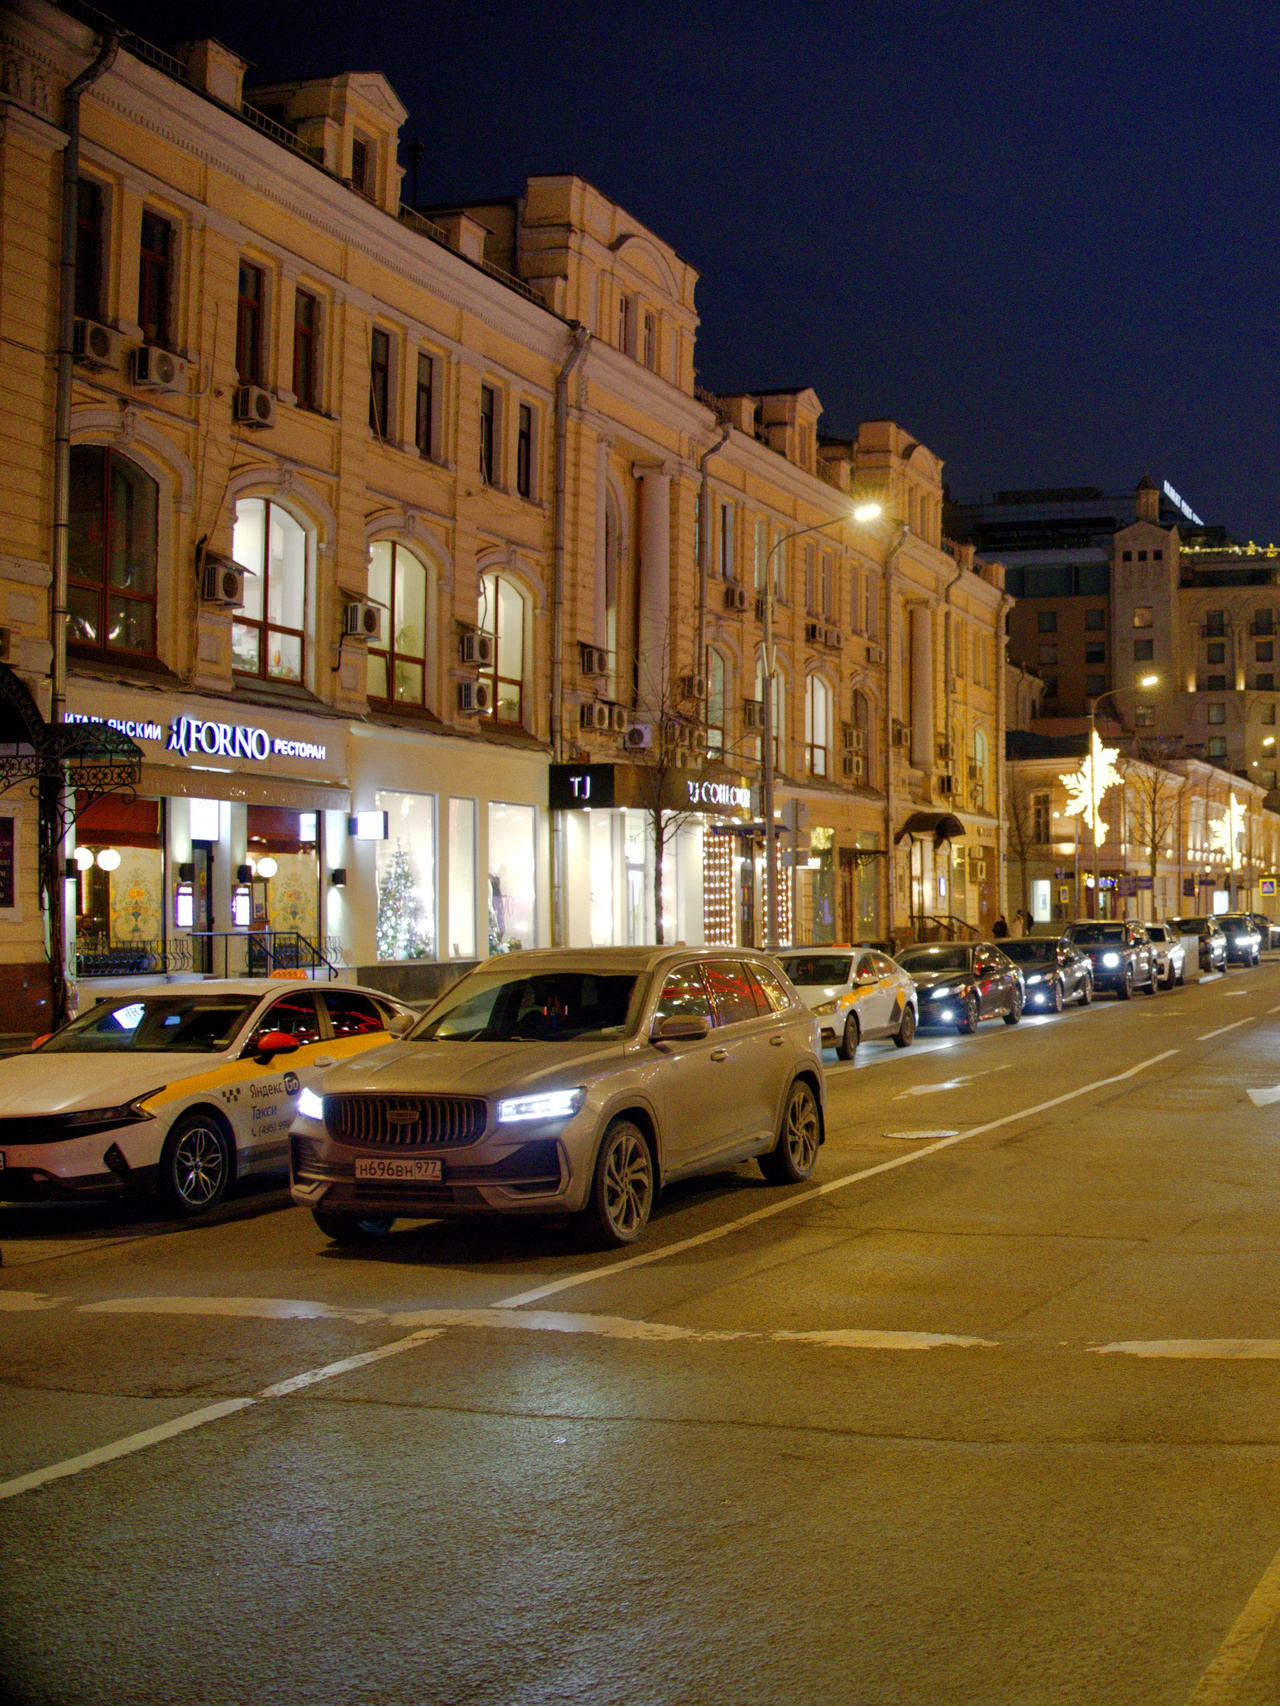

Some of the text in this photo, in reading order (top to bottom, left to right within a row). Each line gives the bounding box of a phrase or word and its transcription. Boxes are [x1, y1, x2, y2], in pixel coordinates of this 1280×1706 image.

[274, 739, 326, 760] РЕСТОРАН
[570, 776, 591, 799] TJ
[250, 1077, 299, 1098] Яндекс Go
[252, 1105, 277, 1120] Такси
[259, 1123, 277, 1136] (495)
[415, 1162, 437, 1174] 977
